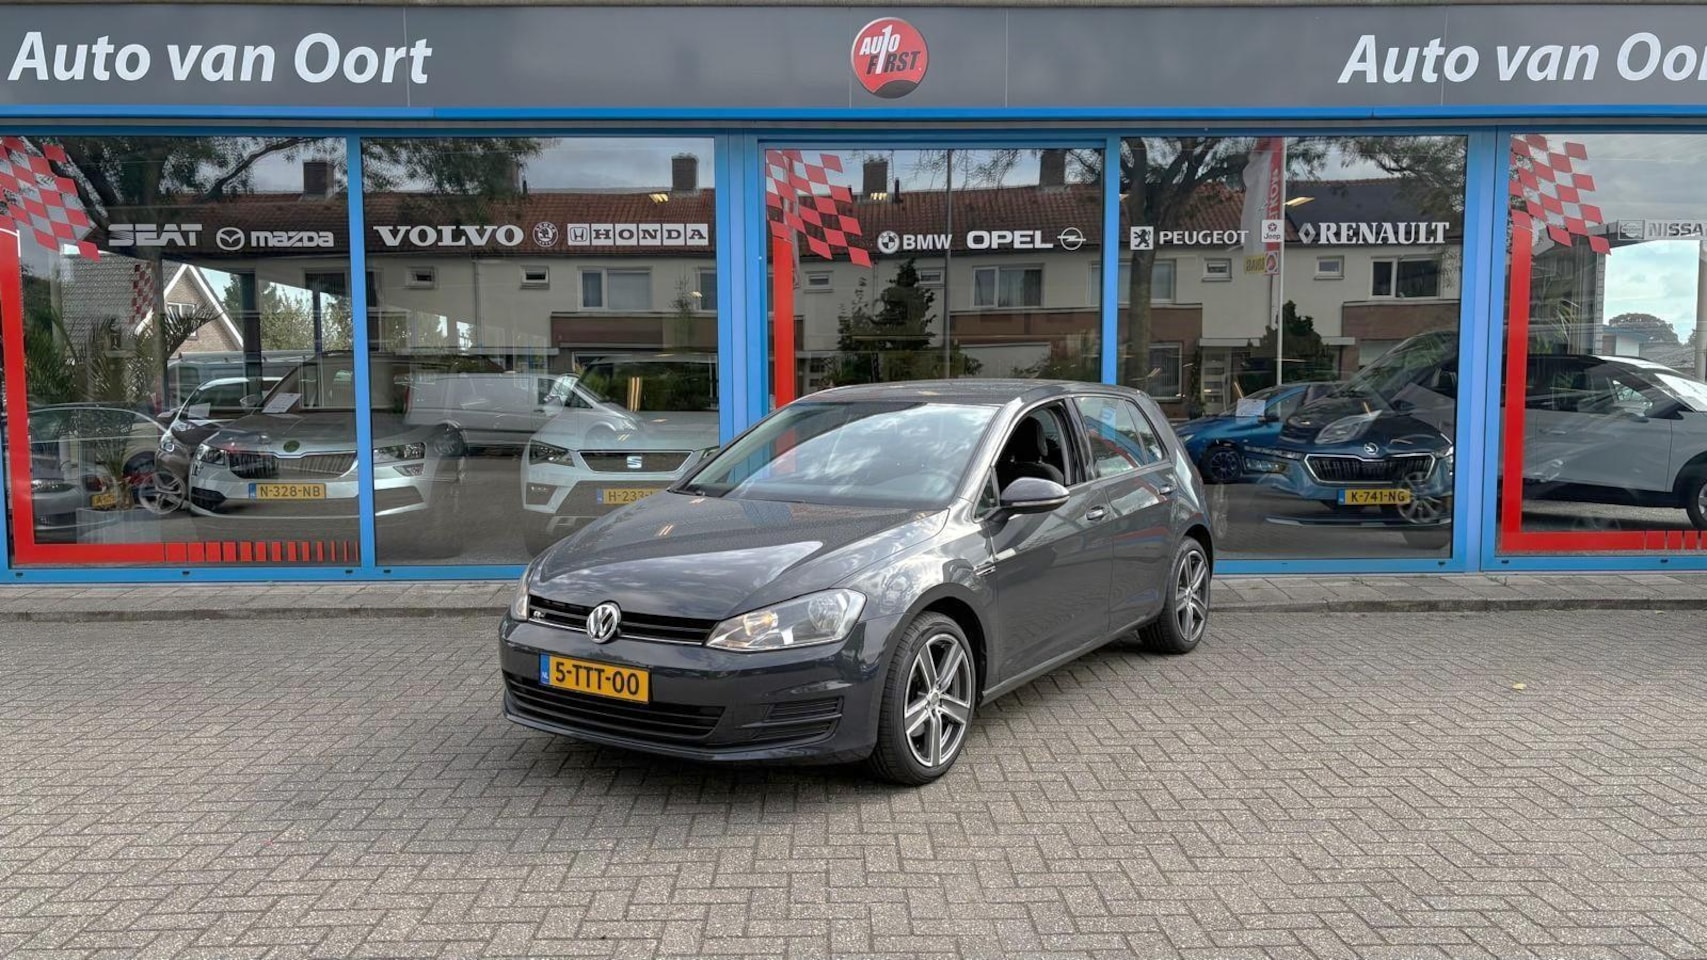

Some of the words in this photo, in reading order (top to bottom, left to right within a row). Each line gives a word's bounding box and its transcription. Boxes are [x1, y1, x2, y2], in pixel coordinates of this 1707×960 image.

[7, 31, 151, 81] Auto
[167, 44, 275, 82] van
[294, 32, 433, 84] Oort
[1337, 34, 1480, 84] Auto
[1496, 44, 1600, 82] van
[108, 223, 203, 247] SEAT
[373, 224, 525, 247] VOLVO
[592, 227, 707, 242] HONDA
[1159, 229, 1250, 245] PEUGEOT
[1263, 232, 1282, 241] Jeep
[1318, 221, 1450, 245] RENAULT
[1648, 222, 1707, 237] NISSA
[250, 230, 335, 248] mazda
[902, 233, 953, 250] BMW
[966, 230, 1054, 250] OPEL
[259, 486, 321, 497] N-328-NB
[608, 490, 654, 502] H-233-
[1351, 490, 1406, 502] K-741-NG
[555, 661, 640, 696] 5-TTT-00
